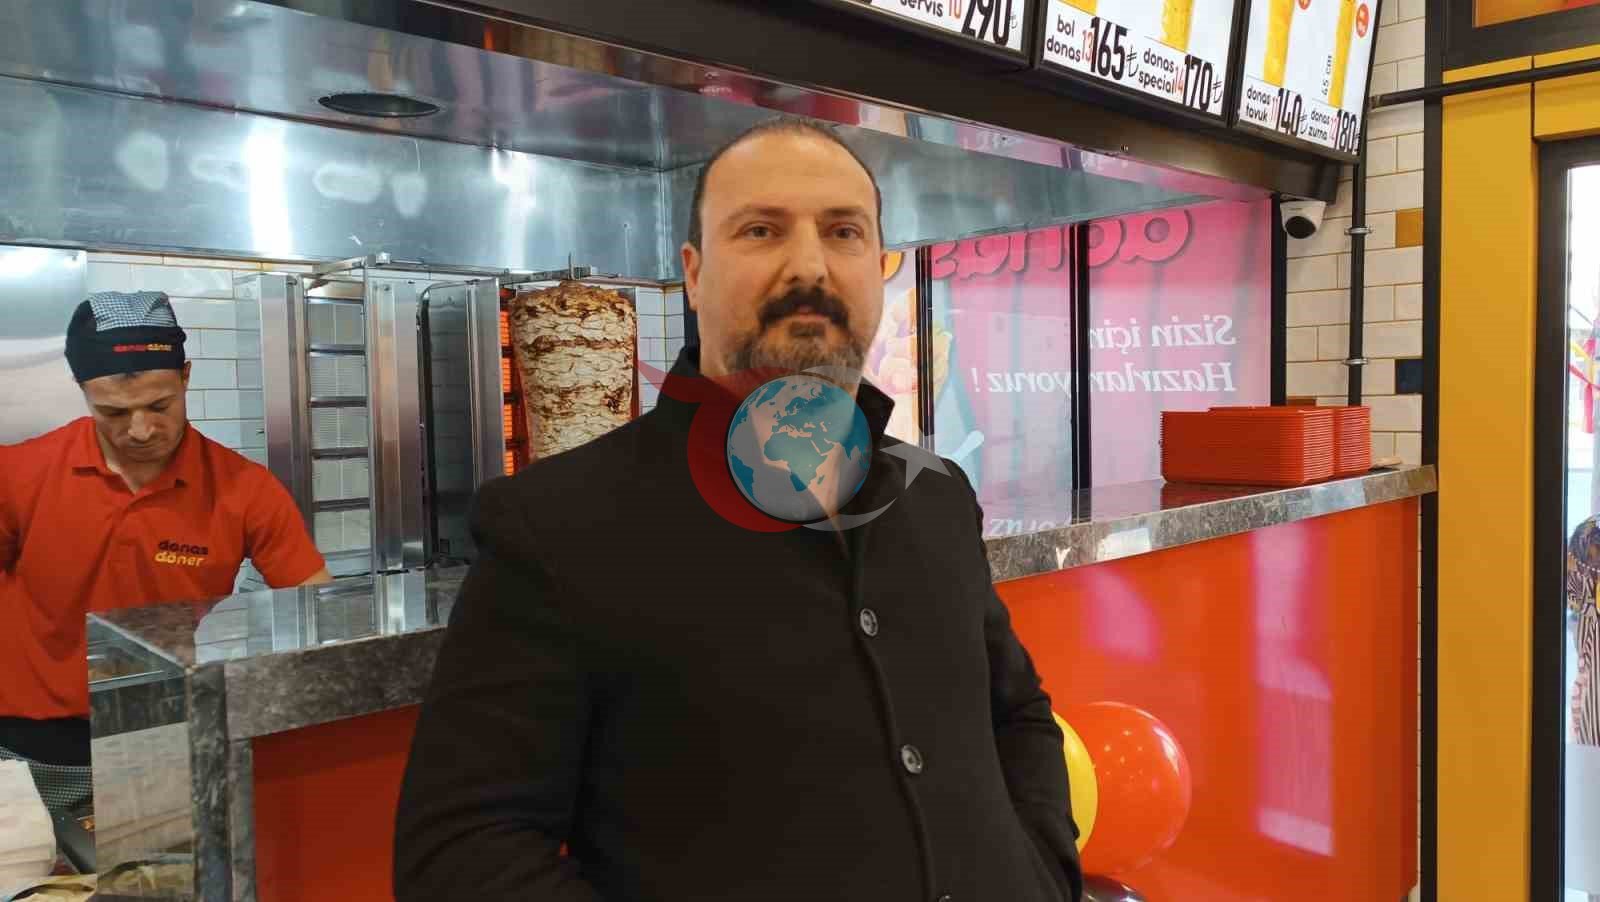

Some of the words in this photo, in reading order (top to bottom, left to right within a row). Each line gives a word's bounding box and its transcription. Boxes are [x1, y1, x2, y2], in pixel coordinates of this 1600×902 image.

[1057, 14, 1075, 38] bol
[1046, 35, 1081, 63] donas
[1143, 48, 1174, 73] donas
[1138, 69, 1175, 94] special
[1246, 83, 1271, 105] donas
[1245, 104, 1269, 122] tavuk
[1310, 107, 1330, 126] donas
[155, 551, 205, 567] döner
